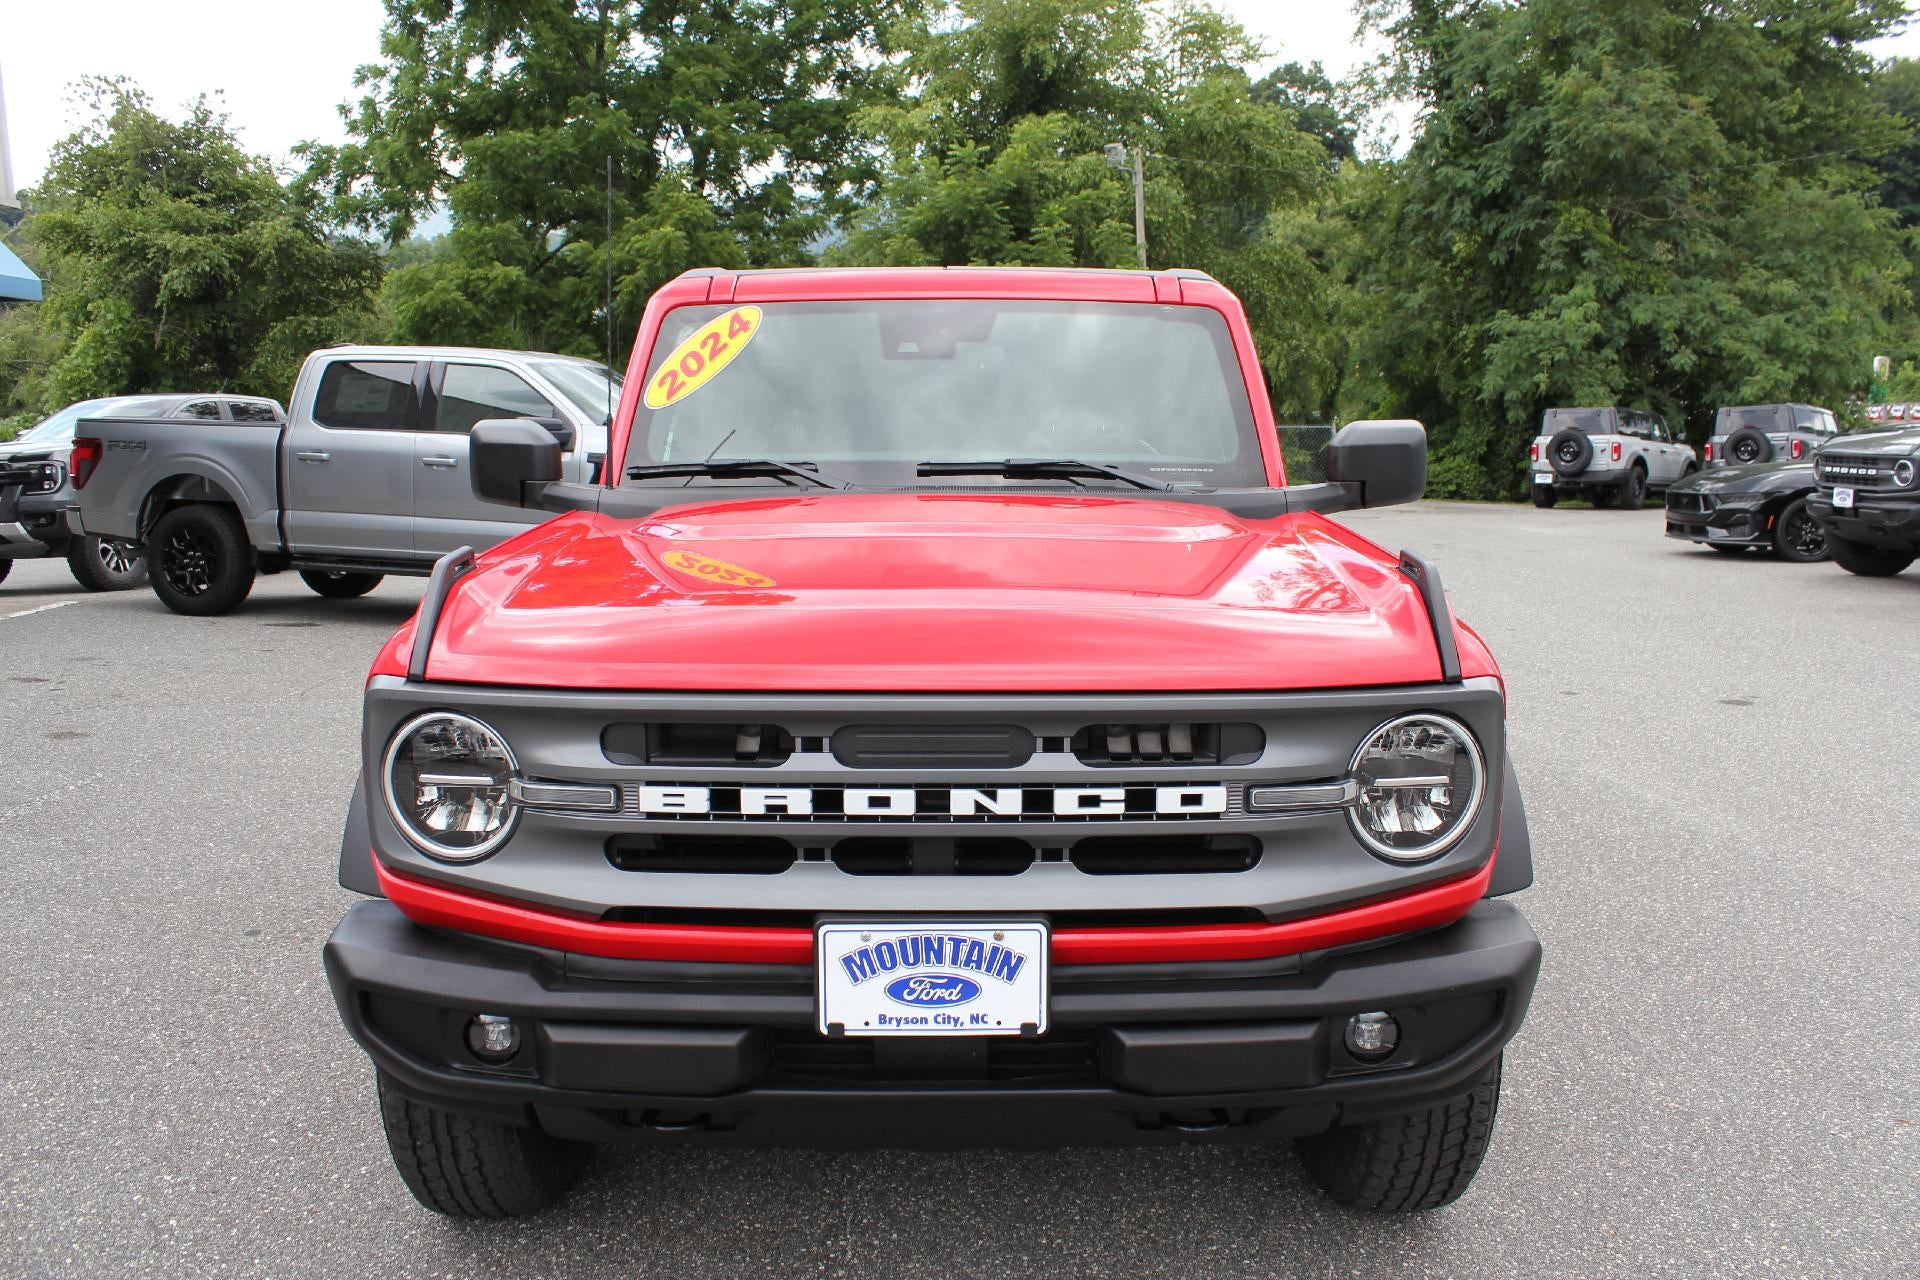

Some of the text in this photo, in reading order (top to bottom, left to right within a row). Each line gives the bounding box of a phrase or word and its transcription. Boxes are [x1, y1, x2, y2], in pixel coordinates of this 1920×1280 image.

[657, 311, 752, 401] 2024
[1825, 466, 1877, 475] BRONCO
[639, 785, 1228, 816] BRONCO
[839, 935, 1026, 985] MOUNTAIN
[902, 977, 963, 1001] Ford
[878, 1013, 988, 1027] Bryson City, NC
